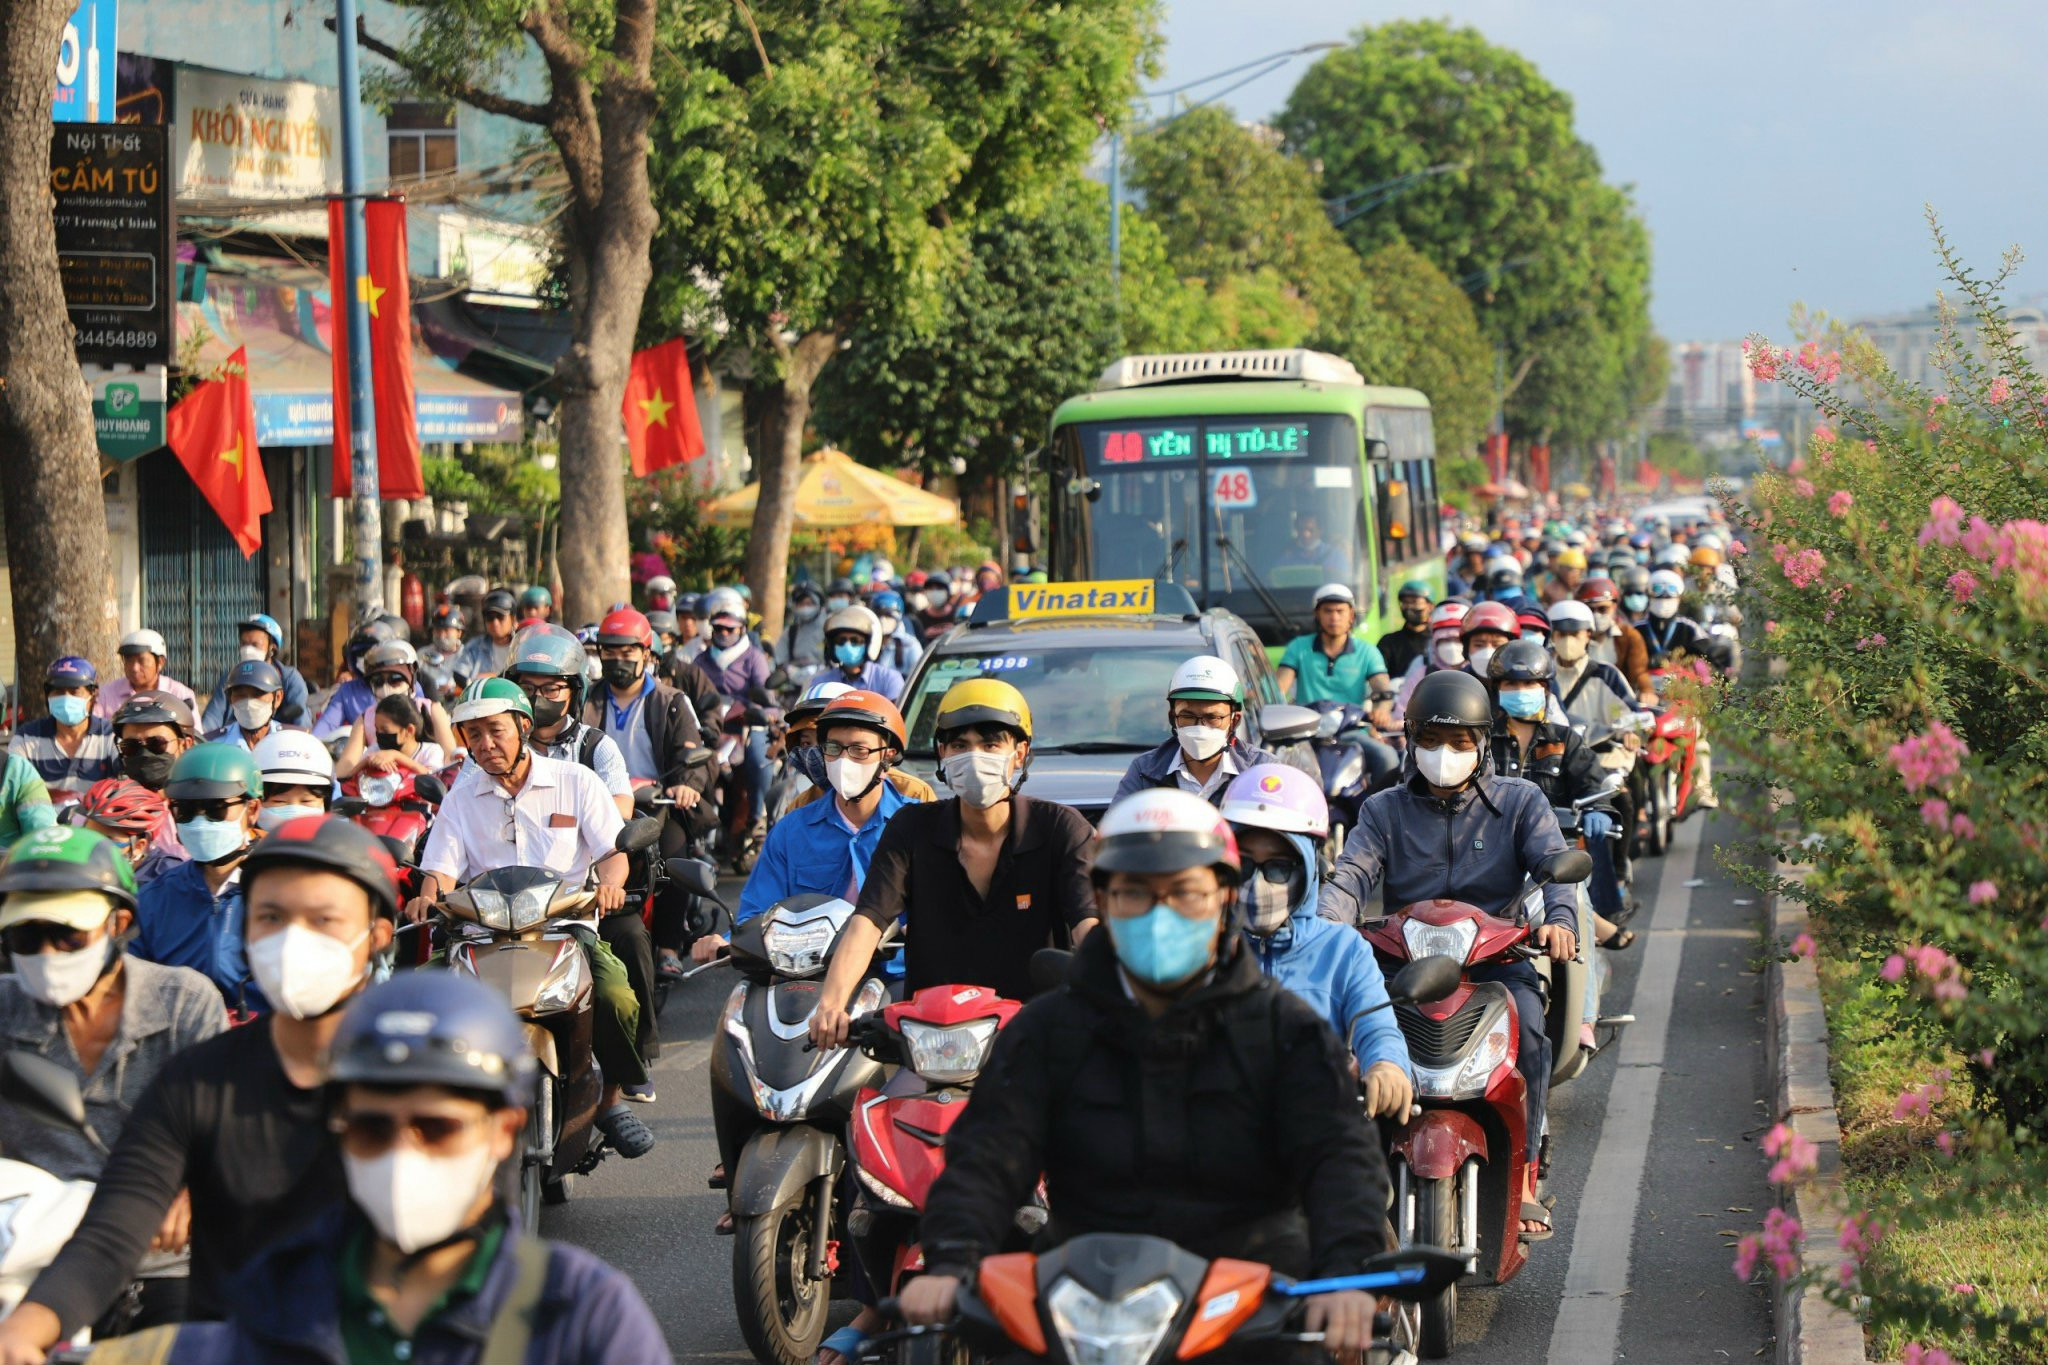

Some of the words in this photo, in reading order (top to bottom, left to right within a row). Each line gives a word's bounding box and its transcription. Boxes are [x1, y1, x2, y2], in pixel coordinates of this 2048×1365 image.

[192, 103, 244, 146] KHÔI
[67, 133, 96, 154] Nội
[52, 156, 114, 192] CẨM
[122, 162, 158, 194] TÚ
[1216, 473, 1250, 501] 48
[1016, 586, 1150, 612] Vinataxi
[981, 657, 1028, 670] 1998
[1427, 714, 1460, 725] Andes
